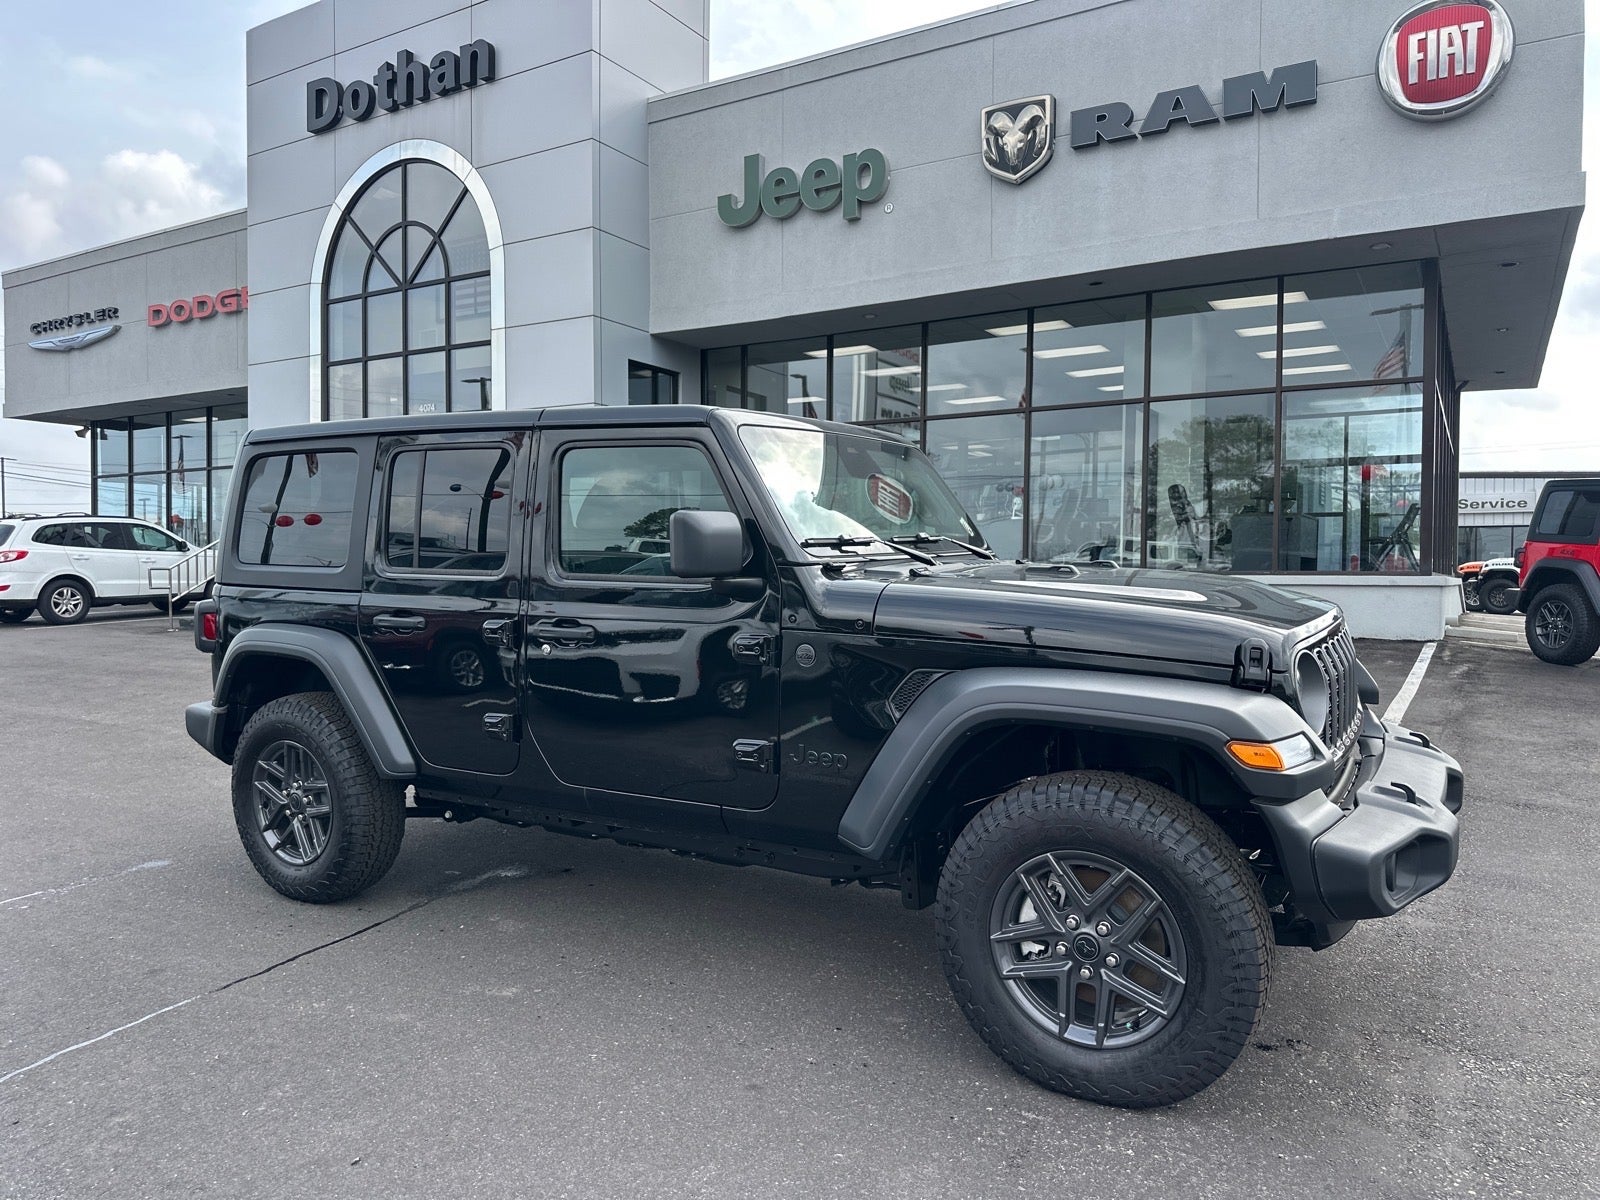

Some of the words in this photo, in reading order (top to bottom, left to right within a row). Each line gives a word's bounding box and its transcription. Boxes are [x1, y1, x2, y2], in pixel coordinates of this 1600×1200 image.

[1407, 20, 1485, 86] FIAT
[306, 38, 496, 135] Dothan
[1070, 59, 1317, 151] RAM
[717, 147, 890, 228] Jeep
[30, 306, 119, 335] CHRYSLER
[1458, 498, 1528, 509] Service
[789, 743, 848, 774] Jeep
